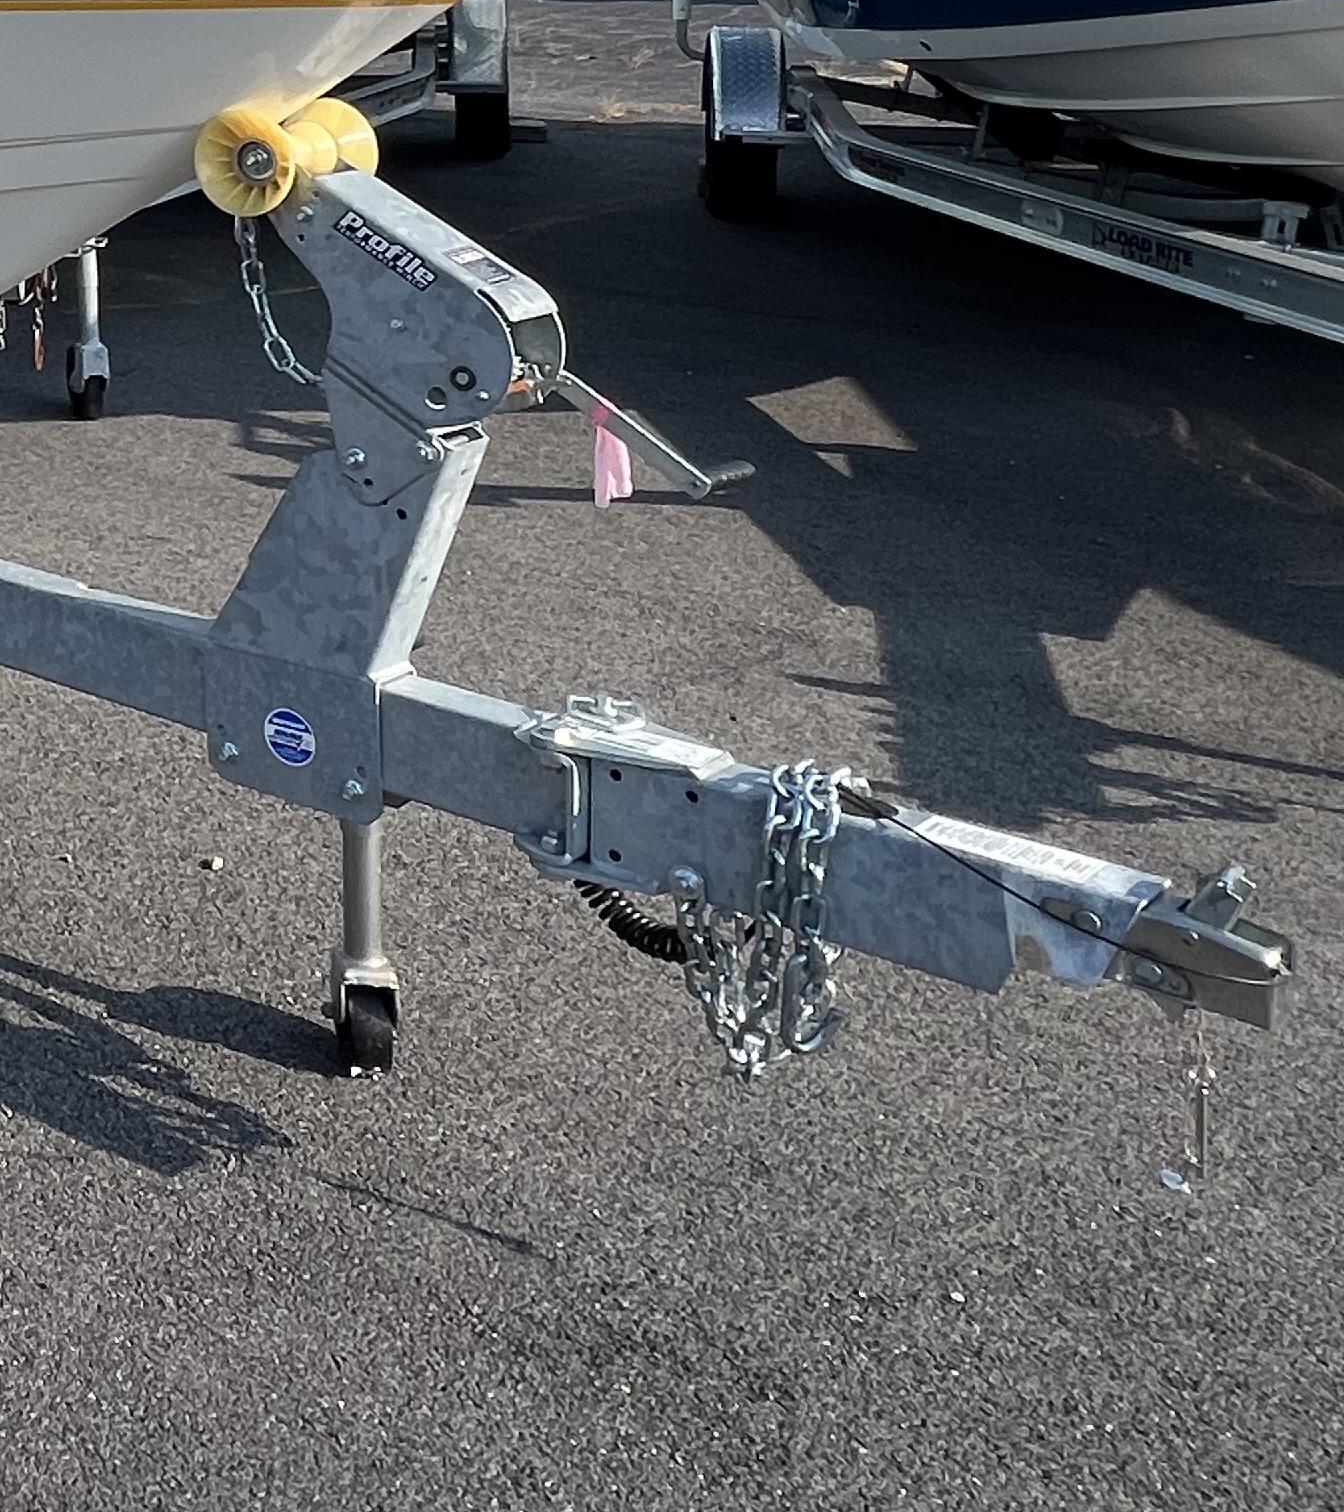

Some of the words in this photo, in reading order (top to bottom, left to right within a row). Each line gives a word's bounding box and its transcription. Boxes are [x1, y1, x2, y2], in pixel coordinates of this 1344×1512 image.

[340, 211, 436, 286] Profile
[1108, 228, 1153, 252] LOAD
[1155, 242, 1194, 268] RITE
